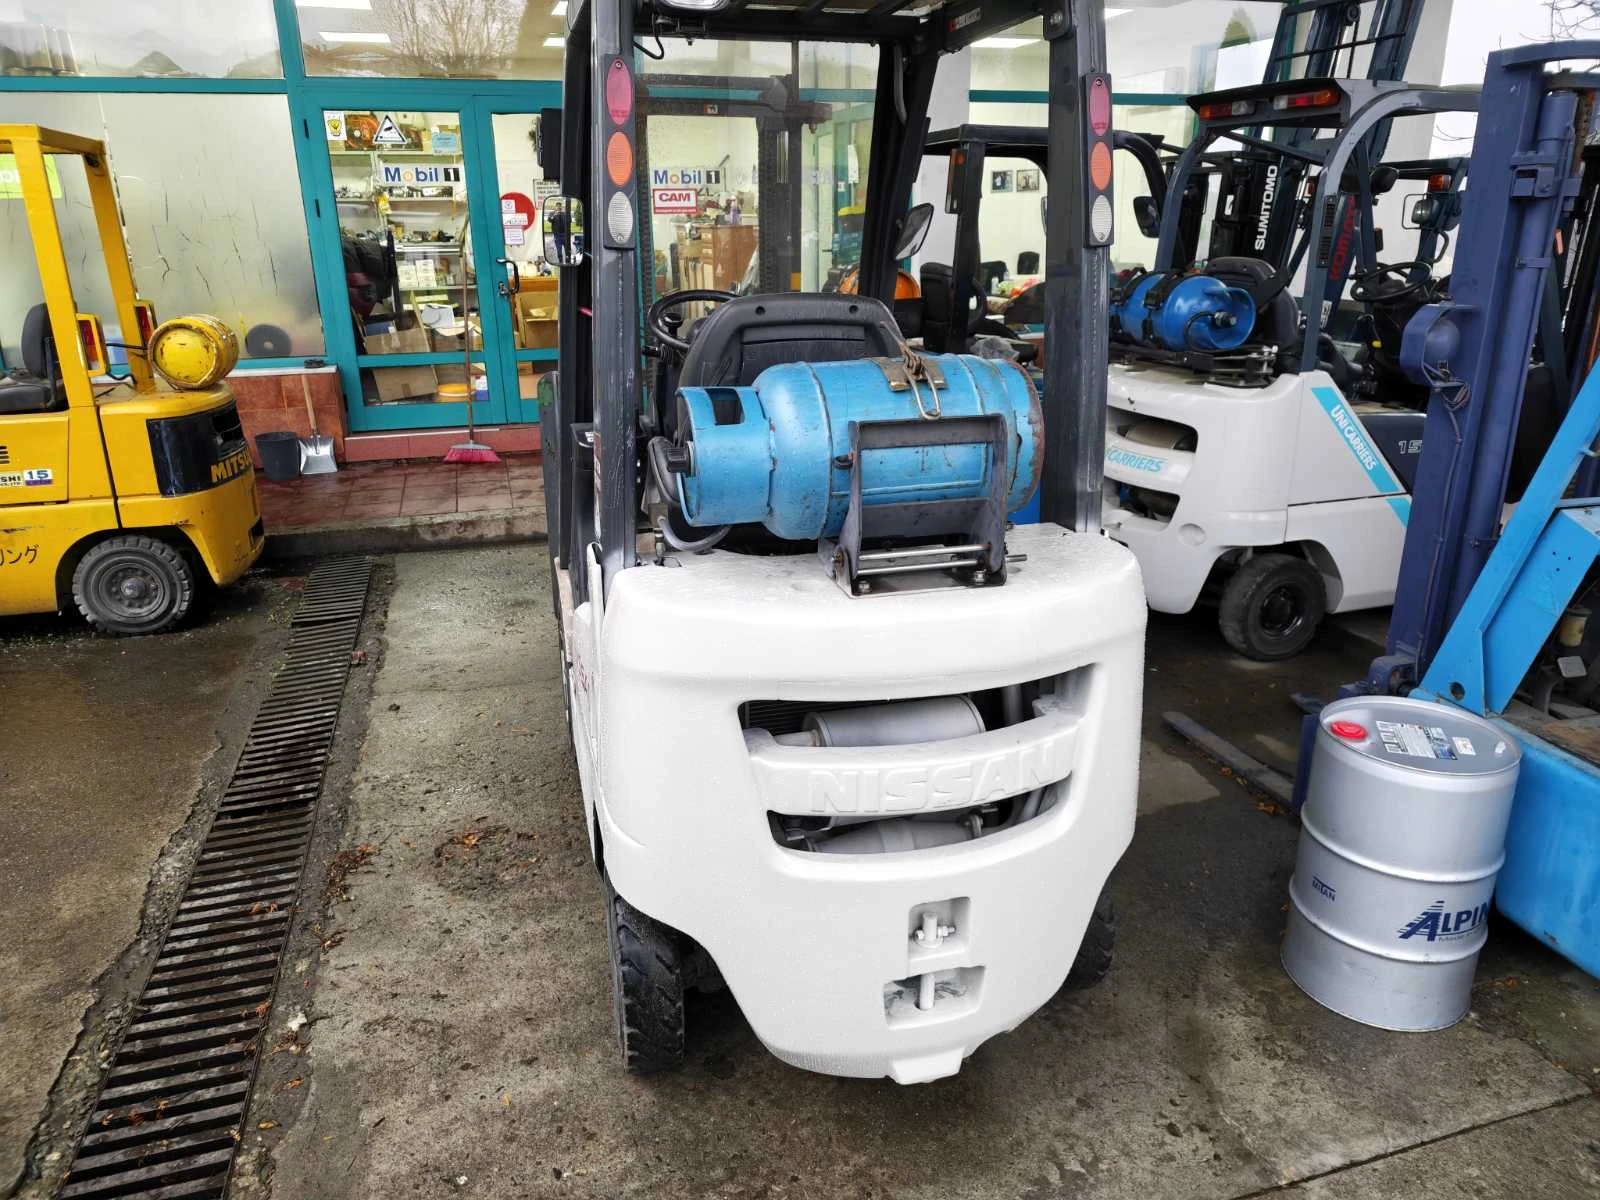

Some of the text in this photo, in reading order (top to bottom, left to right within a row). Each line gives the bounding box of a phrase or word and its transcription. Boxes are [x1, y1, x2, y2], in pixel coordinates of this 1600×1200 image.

[384, 167, 458, 182] Mobil 1
[654, 170, 719, 184] Mobil 1
[658, 192, 691, 203] CAM
[1254, 165, 1278, 251] SUMITOMO
[1398, 439, 1423, 454] 15
[27, 470, 49, 480] 15
[806, 741, 1057, 814] NISSAN
